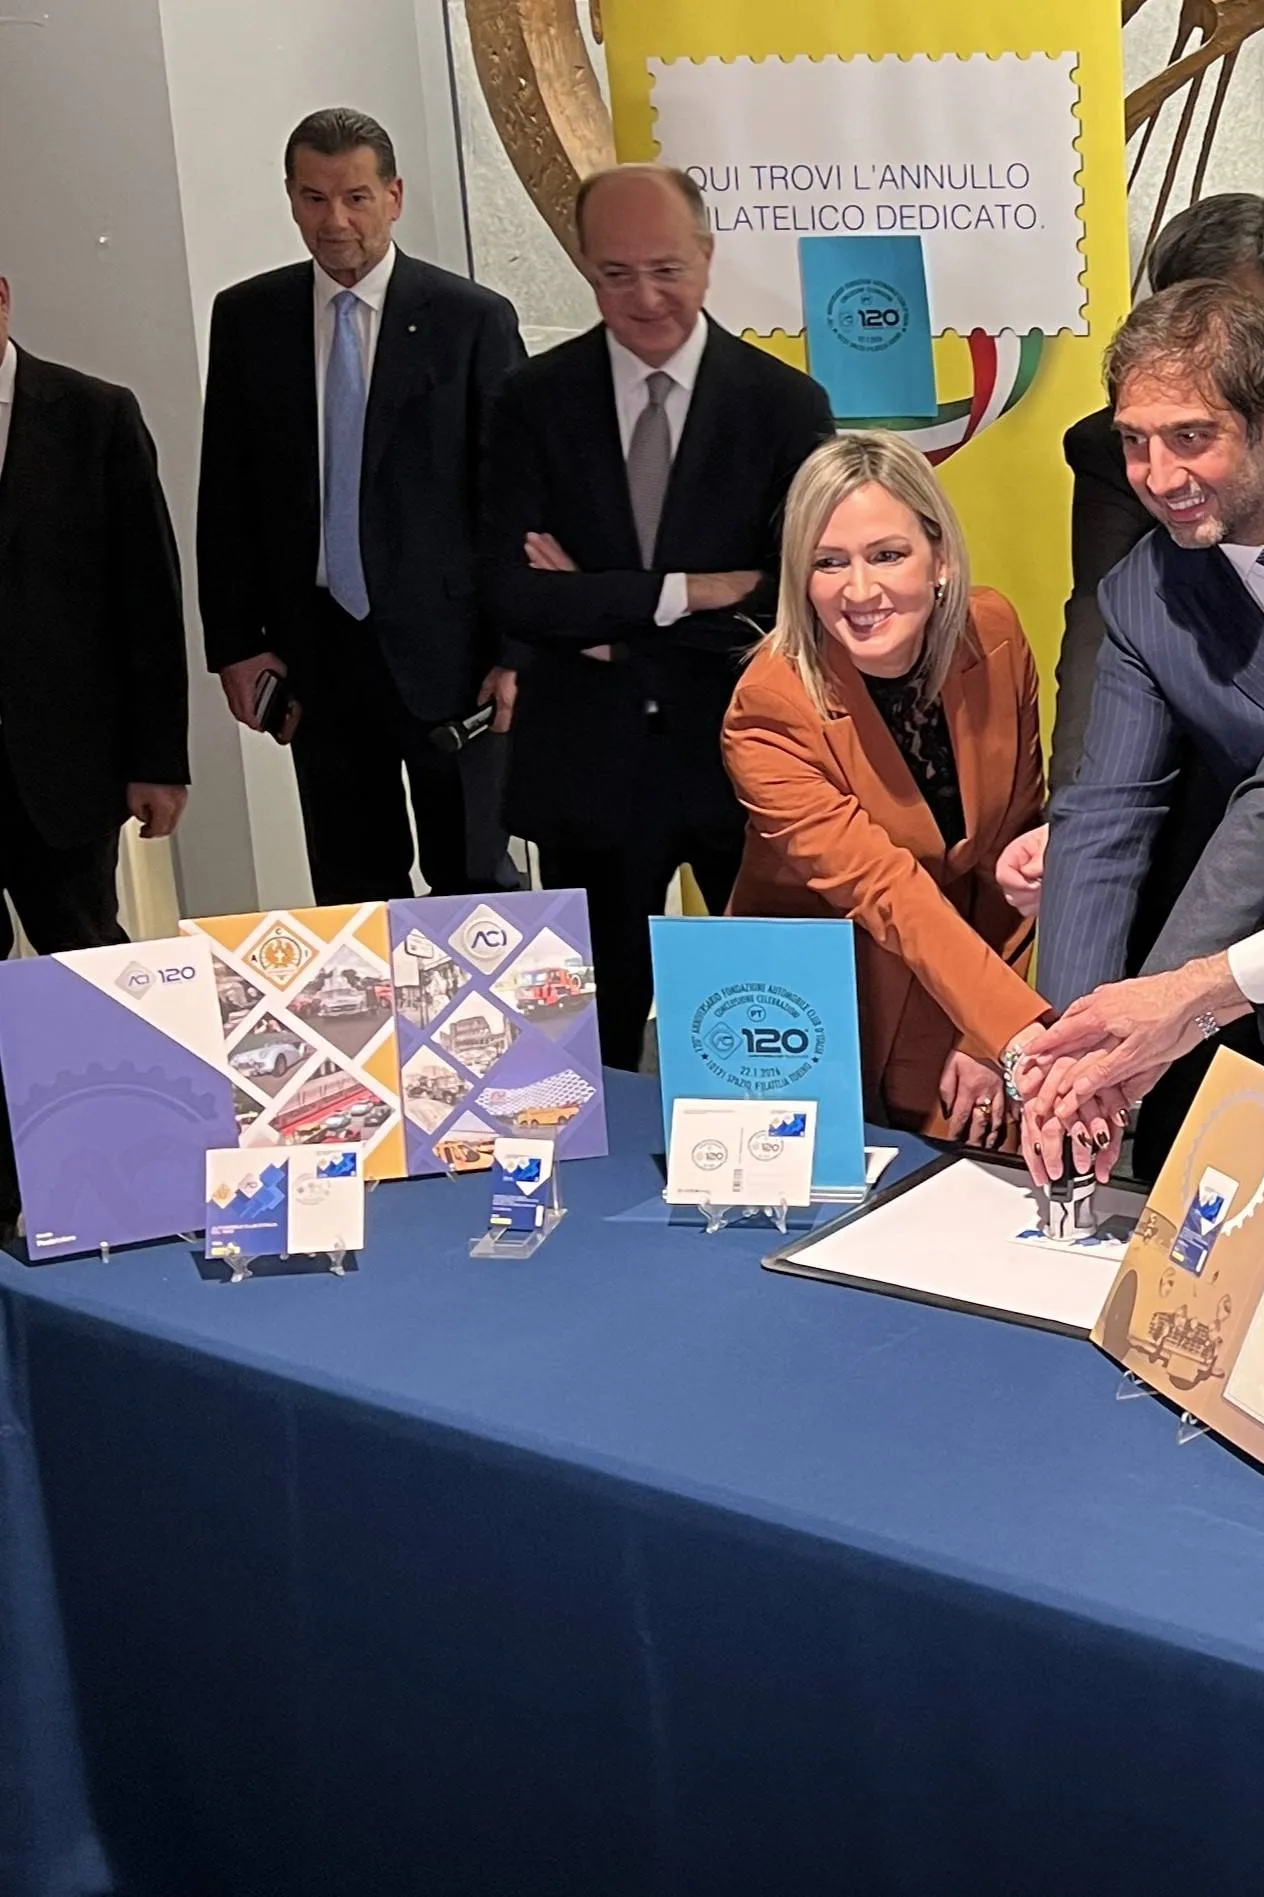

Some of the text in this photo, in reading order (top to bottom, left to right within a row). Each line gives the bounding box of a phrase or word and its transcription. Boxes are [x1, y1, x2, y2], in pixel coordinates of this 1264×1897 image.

[686, 162, 1030, 192] QUI TROVI L'ANNULLO
[705, 203, 1046, 231] ILATELICO DEDICATO.
[857, 308, 900, 328] 120
[471, 929, 508, 949] ACI
[128, 966, 196, 987] ACI 120
[750, 1009, 763, 1018] PT
[741, 1028, 810, 1054] 120
